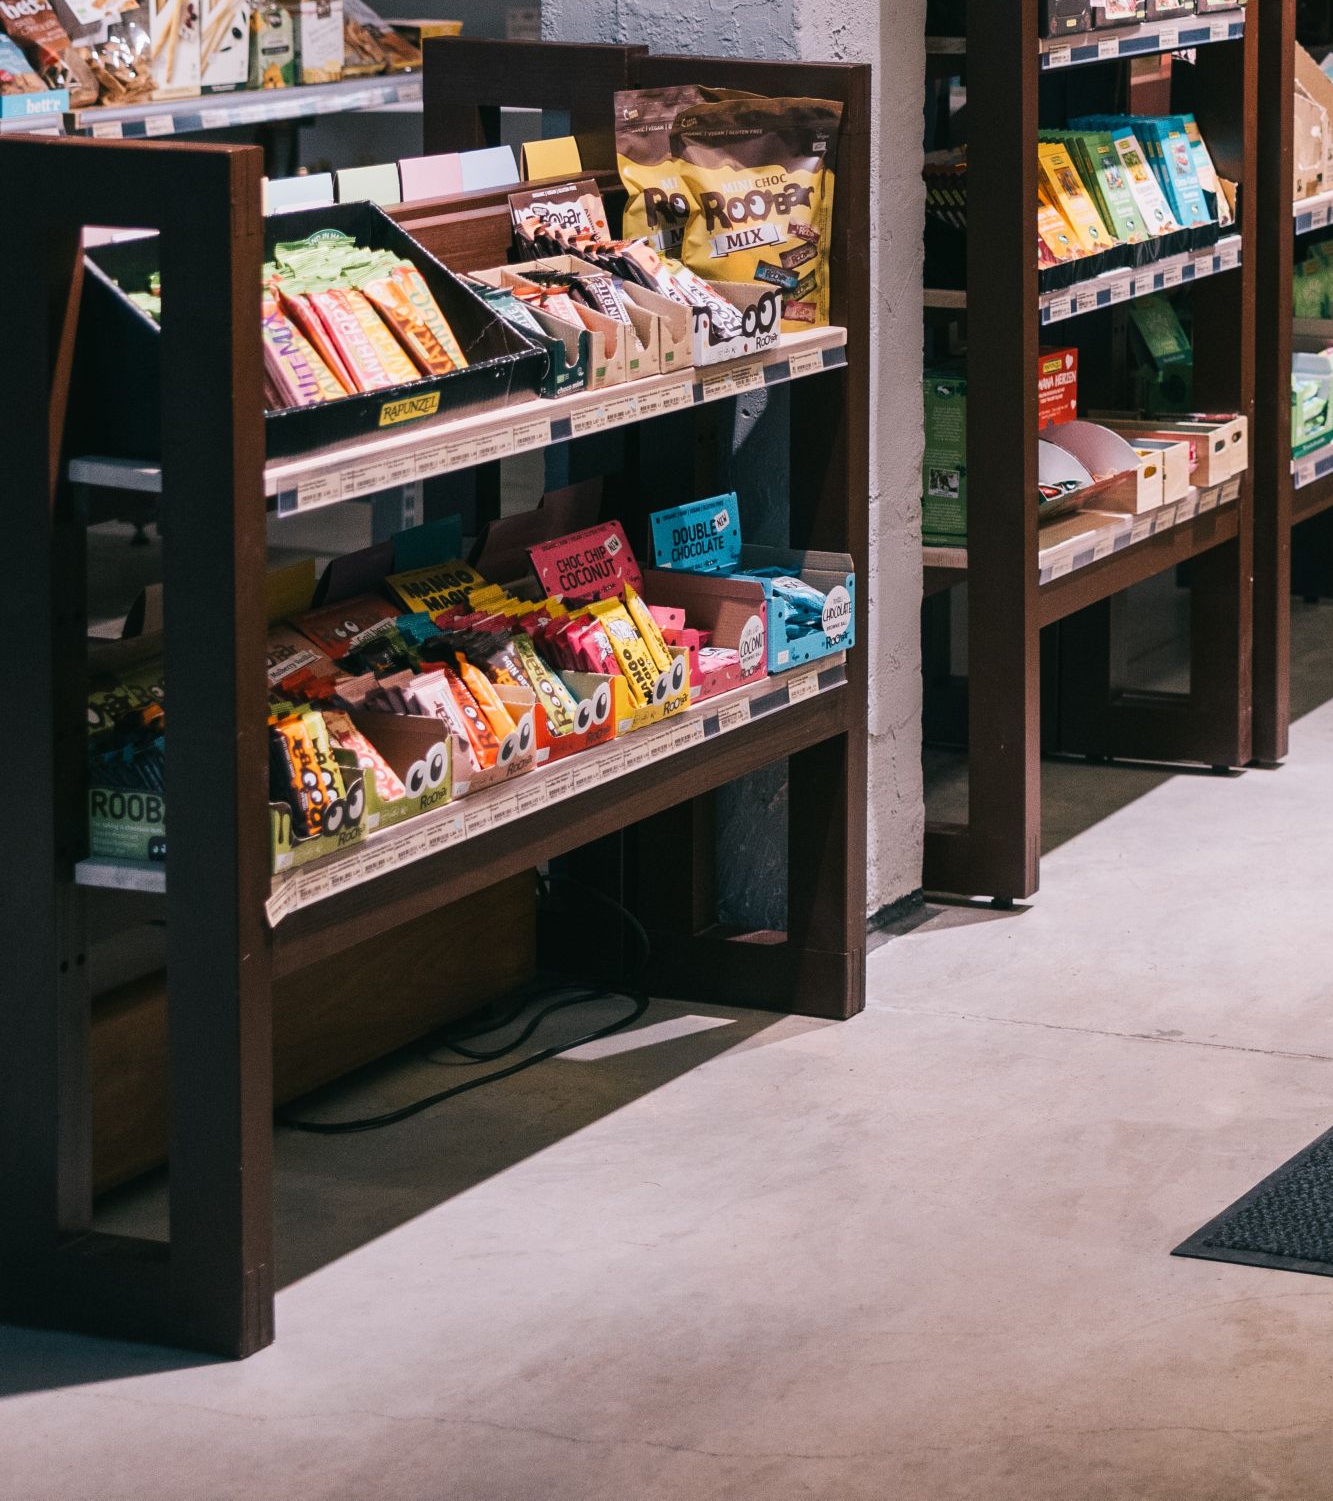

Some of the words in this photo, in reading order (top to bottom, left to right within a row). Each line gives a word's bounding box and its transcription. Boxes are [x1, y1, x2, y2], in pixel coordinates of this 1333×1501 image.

[755, 173, 787, 190] CHOC
[726, 227, 764, 250] MIX
[382, 394, 438, 420] RAPUNZEL
[672, 518, 717, 546] DOUBLE
[716, 512, 727, 527] NEW
[607, 536, 619, 553] NEW
[671, 535, 725, 562] CHOCOLATE
[556, 554, 584, 573] CHOC
[584, 546, 607, 564] CHIP
[402, 571, 475, 598] MANGO
[559, 558, 617, 592] COCONUT
[823, 602, 853, 622] CHOCOLATE
[740, 631, 767, 657] COCONUT
[501, 653, 519, 677] Nibs
[621, 646, 656, 705] MANGO
[636, 656, 655, 688] AGIC
[91, 790, 165, 824] ROOB
